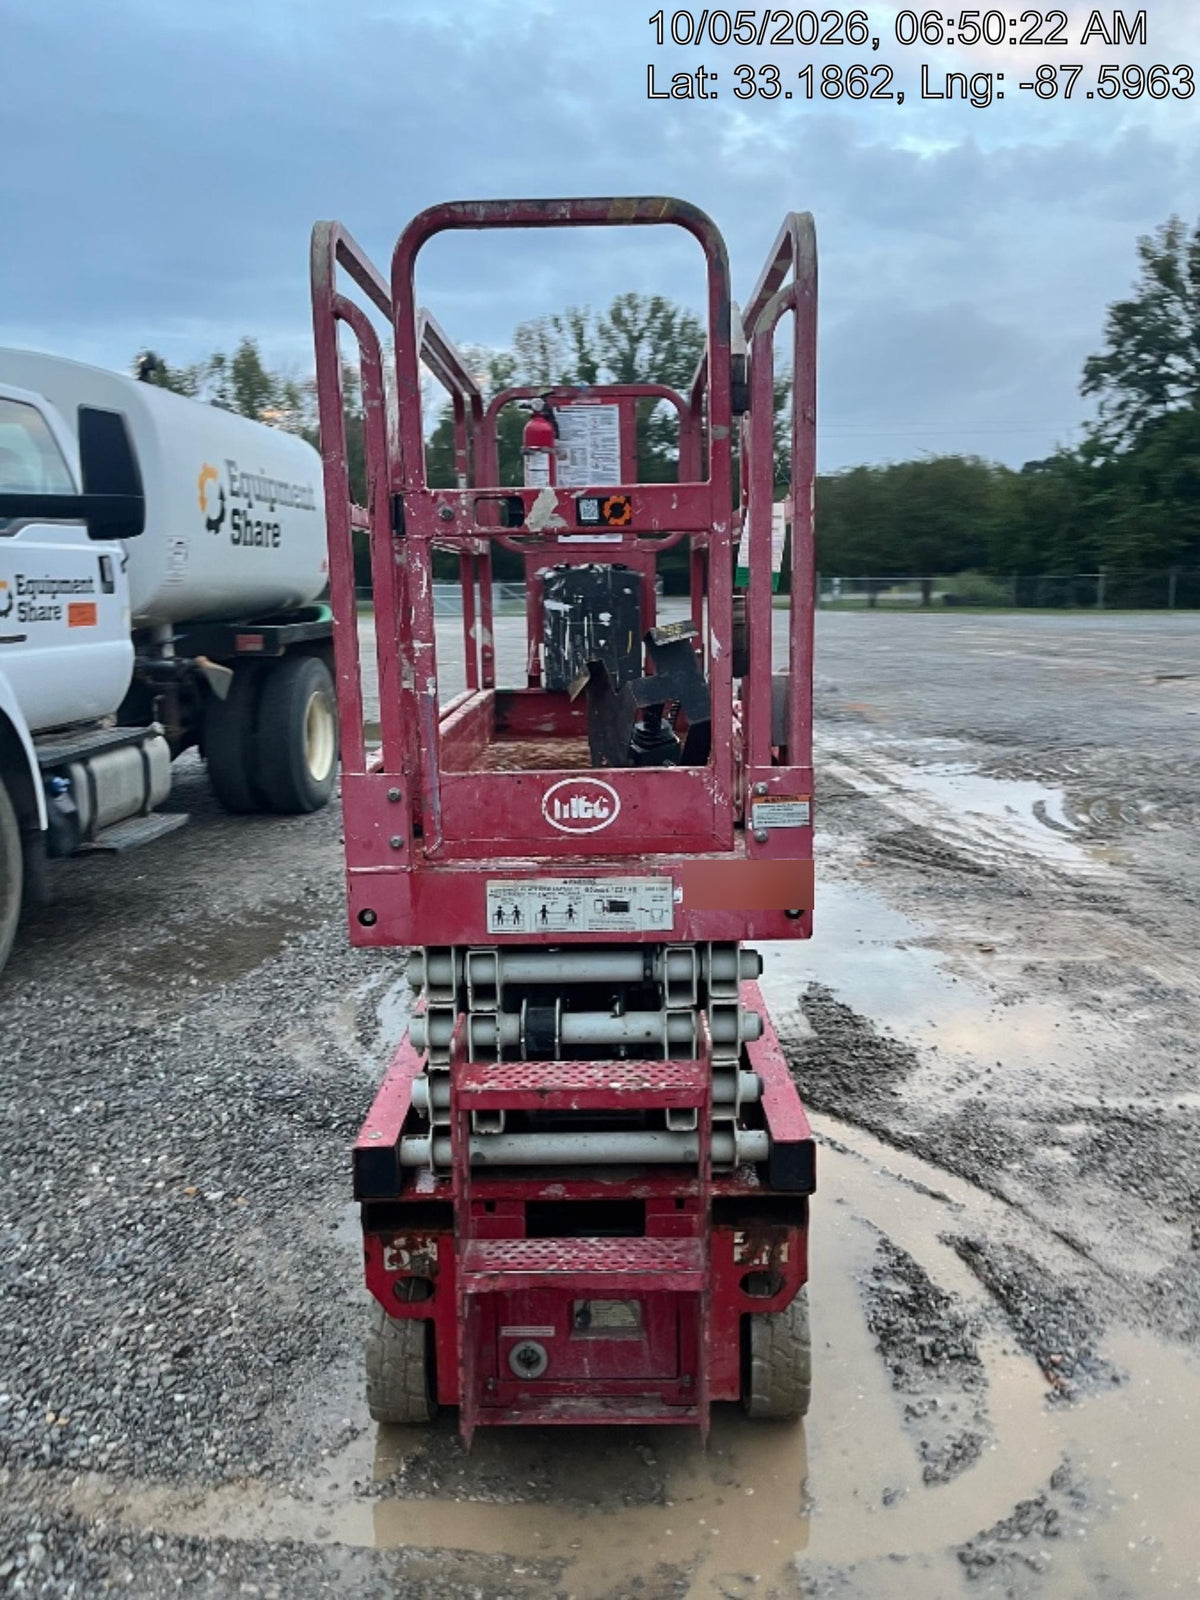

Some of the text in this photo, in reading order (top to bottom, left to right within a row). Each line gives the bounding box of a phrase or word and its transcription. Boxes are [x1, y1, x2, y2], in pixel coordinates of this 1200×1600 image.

[225, 459, 316, 512] Equipment
[231, 508, 281, 548] Share
[15, 574, 95, 600] Equipment
[17, 601, 62, 622] Share
